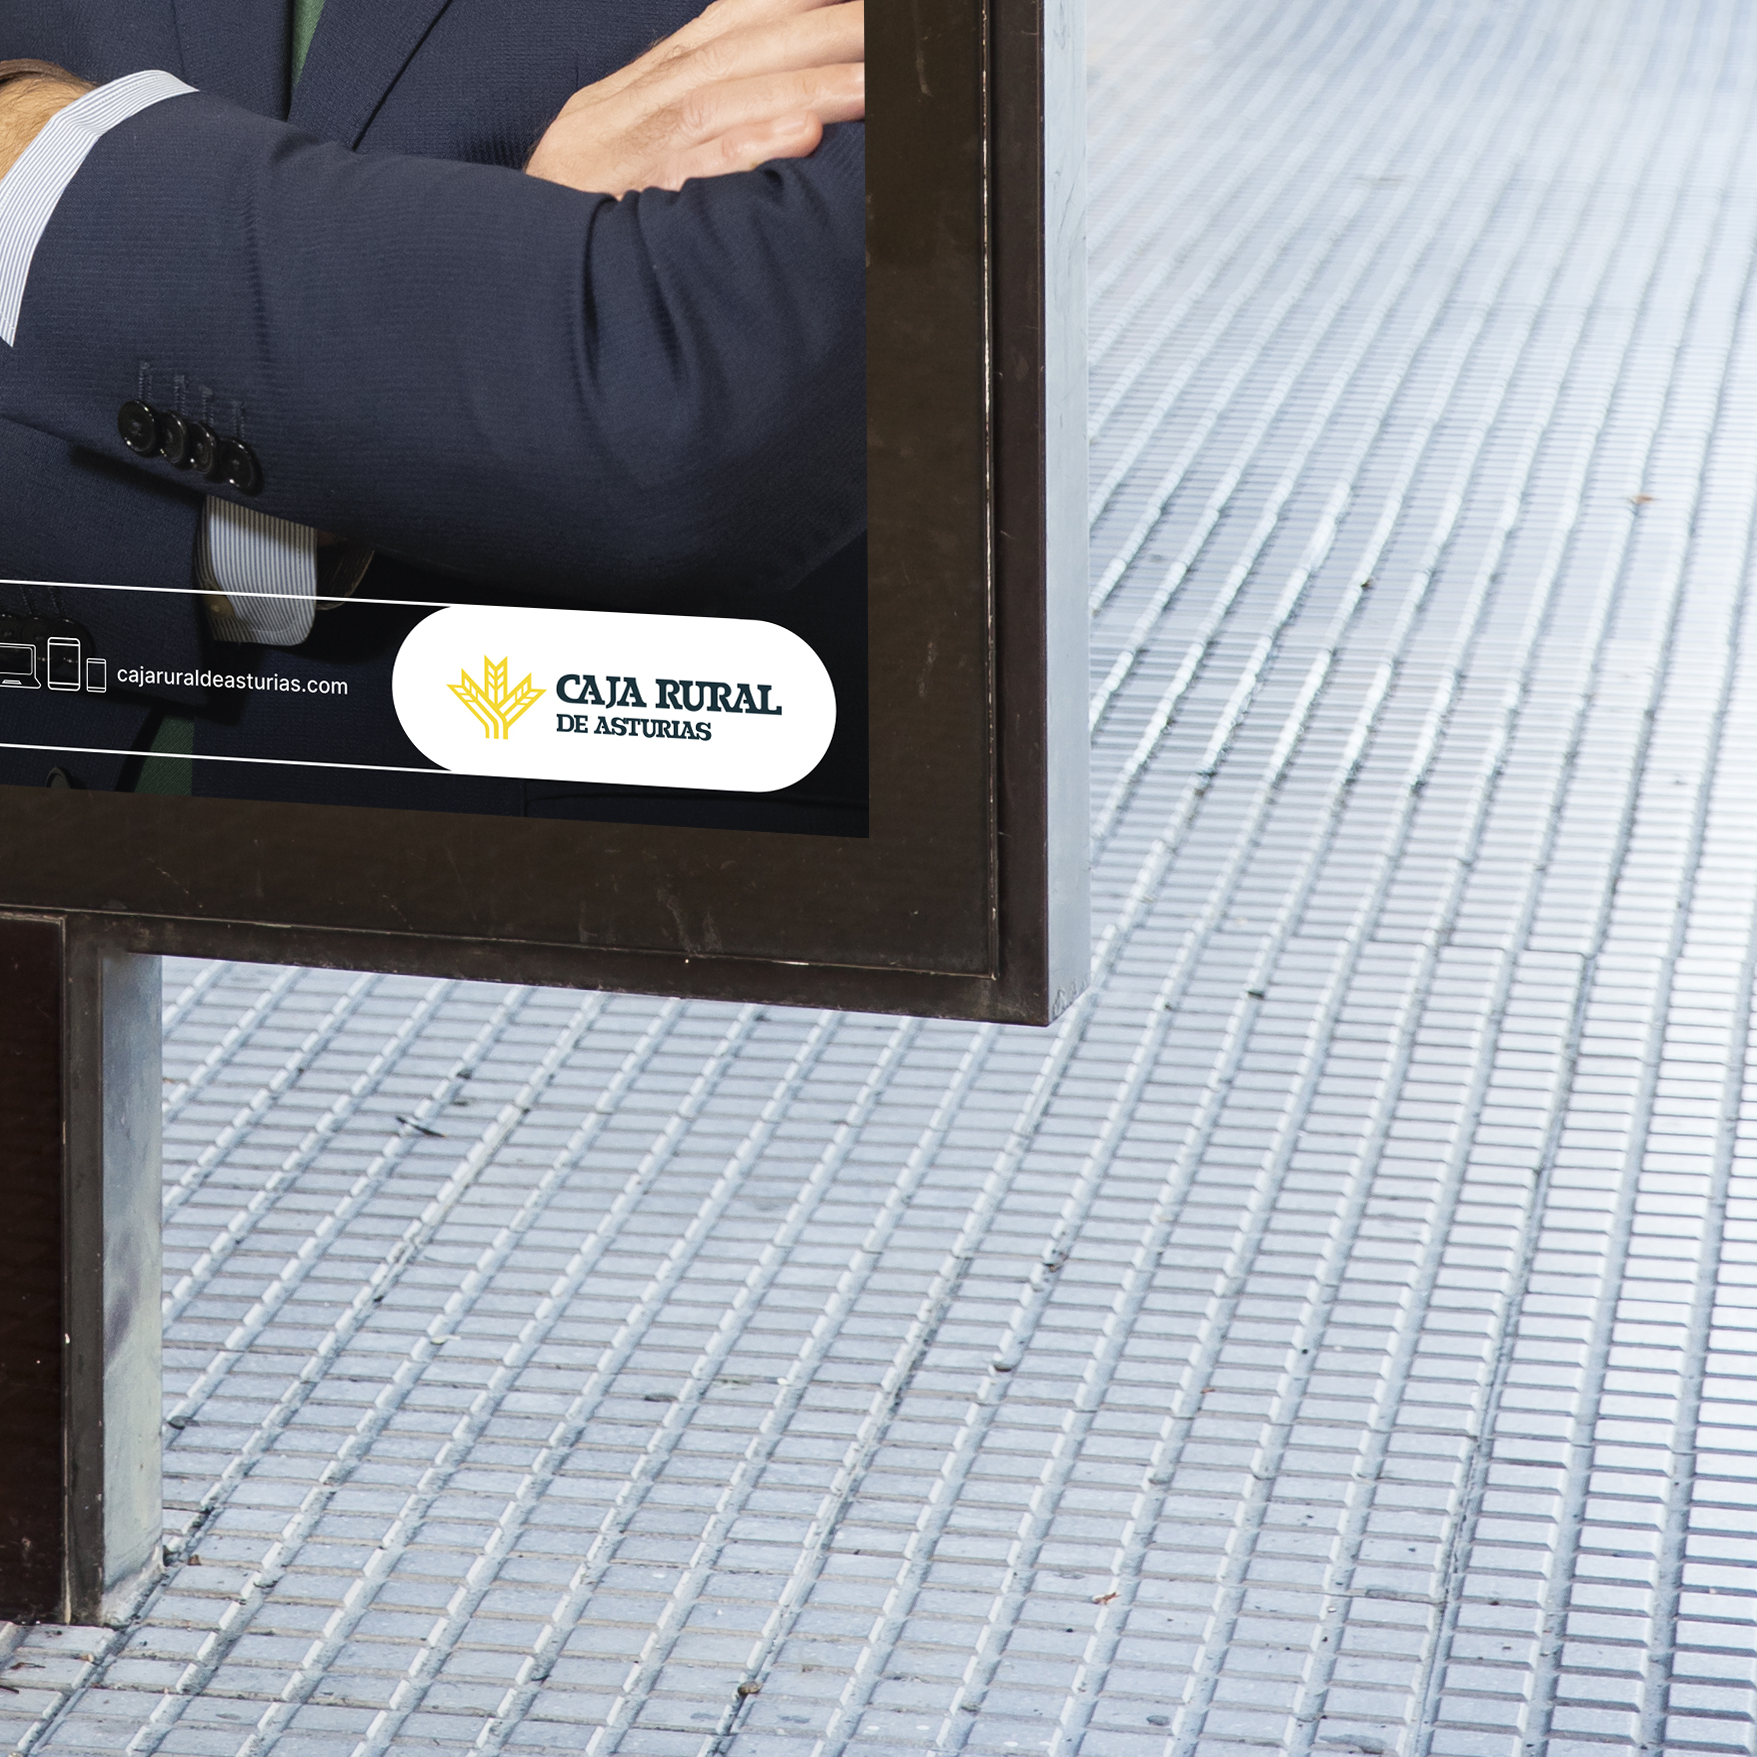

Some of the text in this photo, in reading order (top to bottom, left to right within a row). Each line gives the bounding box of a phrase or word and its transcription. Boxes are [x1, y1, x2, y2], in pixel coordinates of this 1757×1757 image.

[117, 665, 348, 695] cajaruraldeasturias.com
[556, 673, 783, 716] CAJA RURAL
[556, 713, 712, 742] DE ASTURIAS
